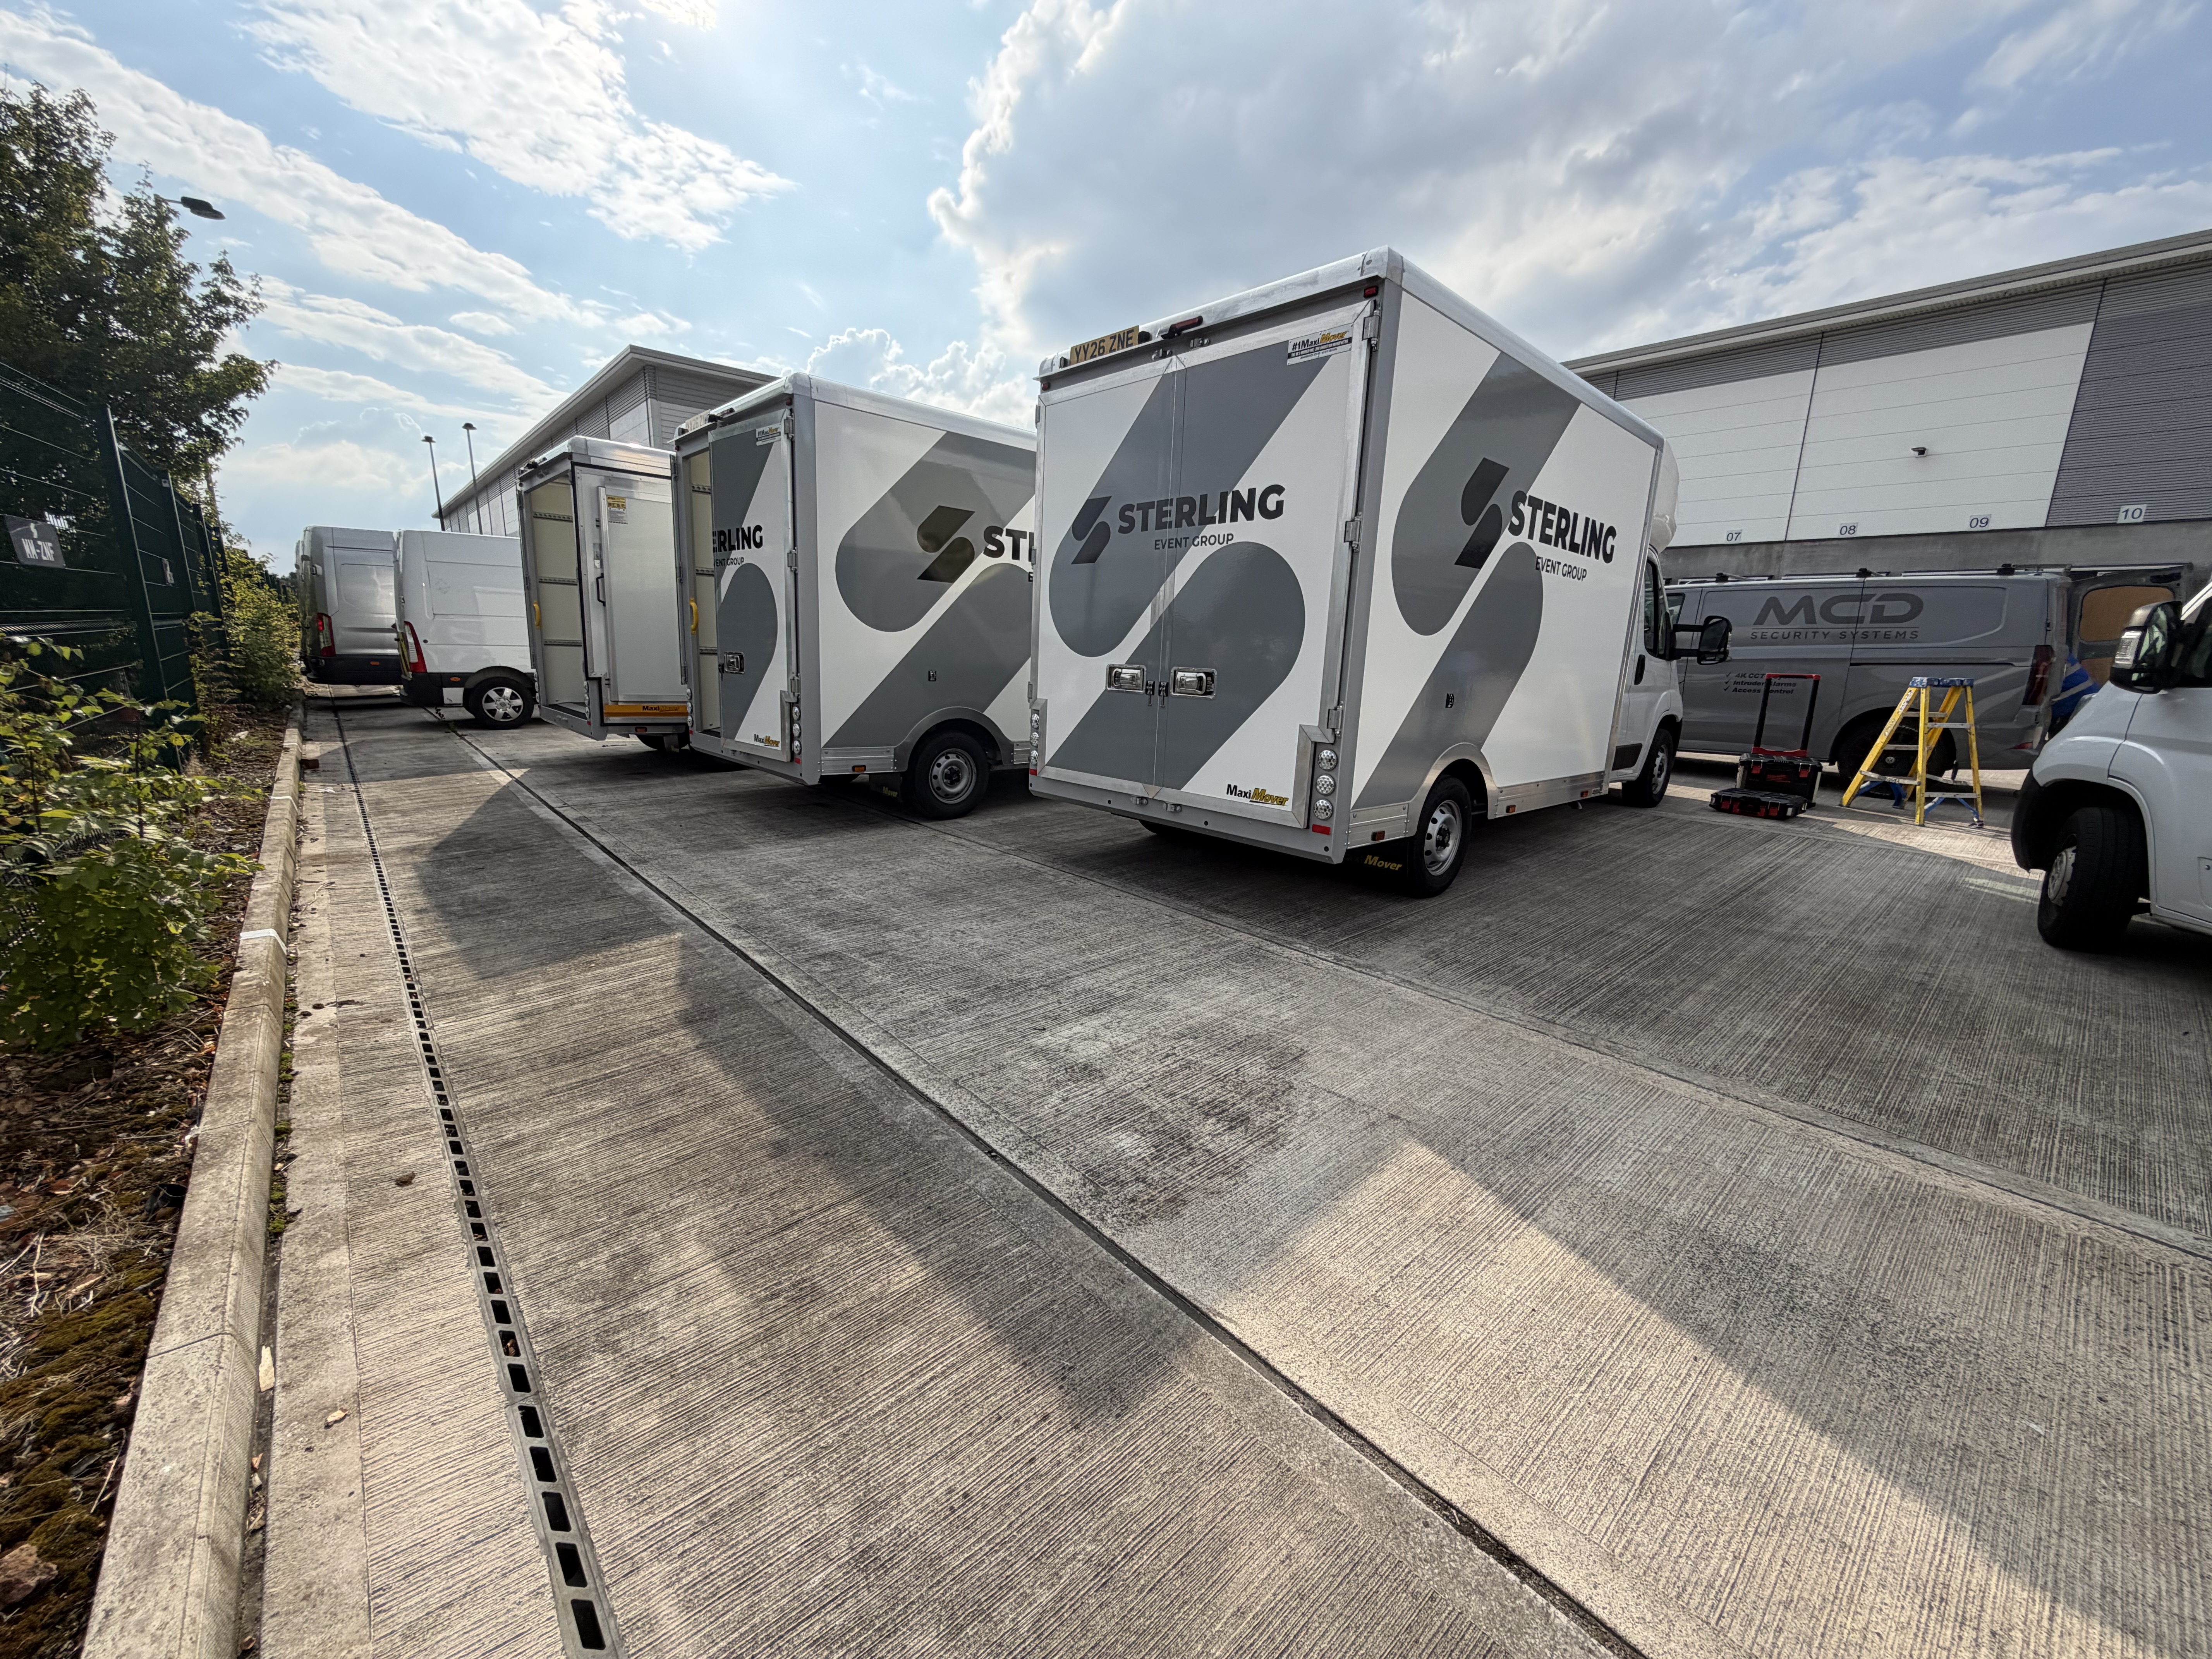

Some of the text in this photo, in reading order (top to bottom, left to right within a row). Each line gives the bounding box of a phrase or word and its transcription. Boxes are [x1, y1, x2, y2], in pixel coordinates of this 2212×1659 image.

[1075, 329, 1134, 364] YY26 ZNE
[1118, 484, 1286, 534] STERLING
[2121, 508, 2143, 520] 10
[1508, 490, 1617, 564] STERLING
[1969, 517, 1989, 528] 09
[1726, 532, 1741, 542] 07
[1839, 525, 1856, 535] 08
[1154, 533, 1234, 550] EVENT GROUP
[726, 557, 744, 566] GROUP
[1535, 556, 1587, 582] EVENT GROUP
[1753, 593, 1924, 625] MCD
[1839, 631, 1919, 639] SYSTEMS
